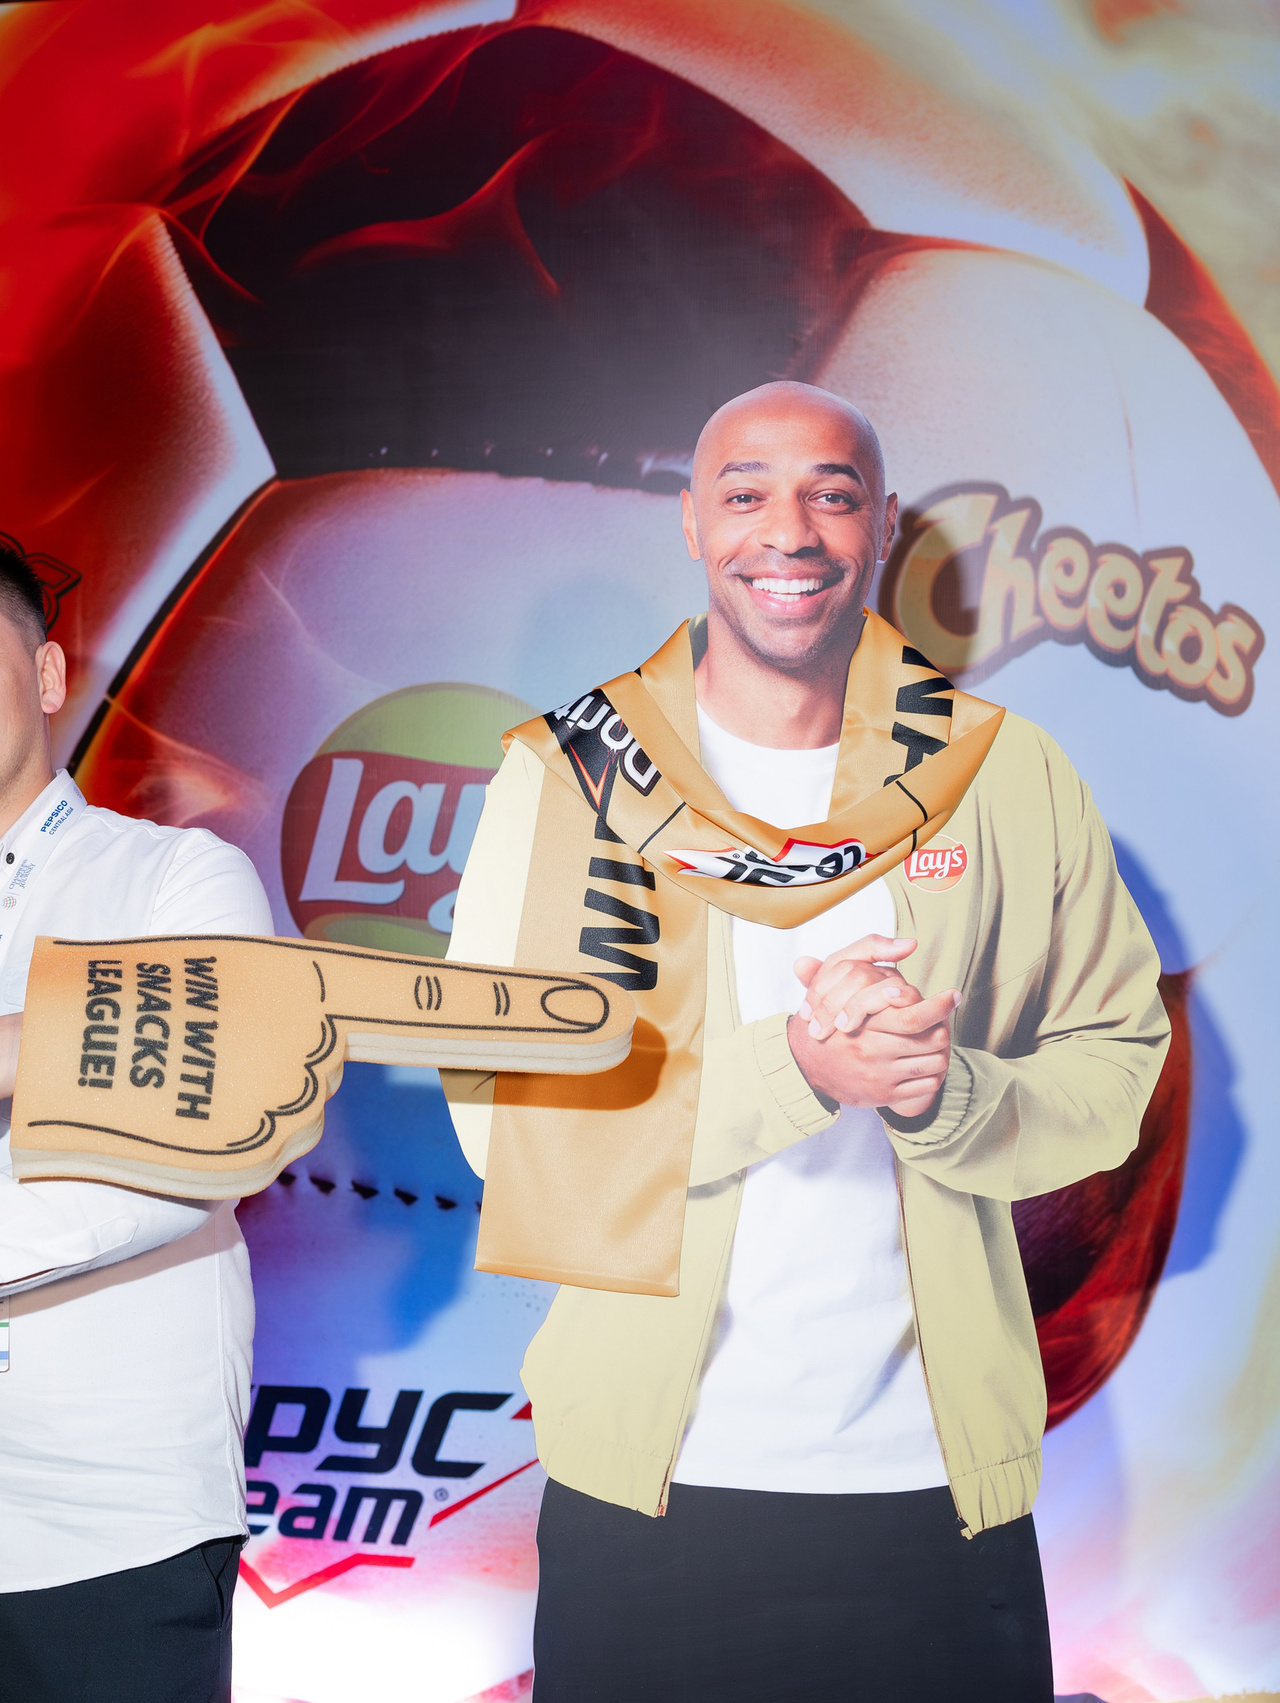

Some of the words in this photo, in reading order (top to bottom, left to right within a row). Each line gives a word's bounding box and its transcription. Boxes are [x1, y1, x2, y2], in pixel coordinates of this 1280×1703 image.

[886, 486, 1263, 714] Cheetos
[40, 799, 68, 833] PEPSICO
[48, 815, 67, 836] CENTRAL
[909, 846, 965, 880] Lay's
[579, 816, 660, 991] WI
[77, 959, 123, 1090] LEAGUE!
[129, 961, 172, 1089] SNACKS
[183, 956, 219, 1012] WIN
[175, 1019, 219, 1121] WITH
